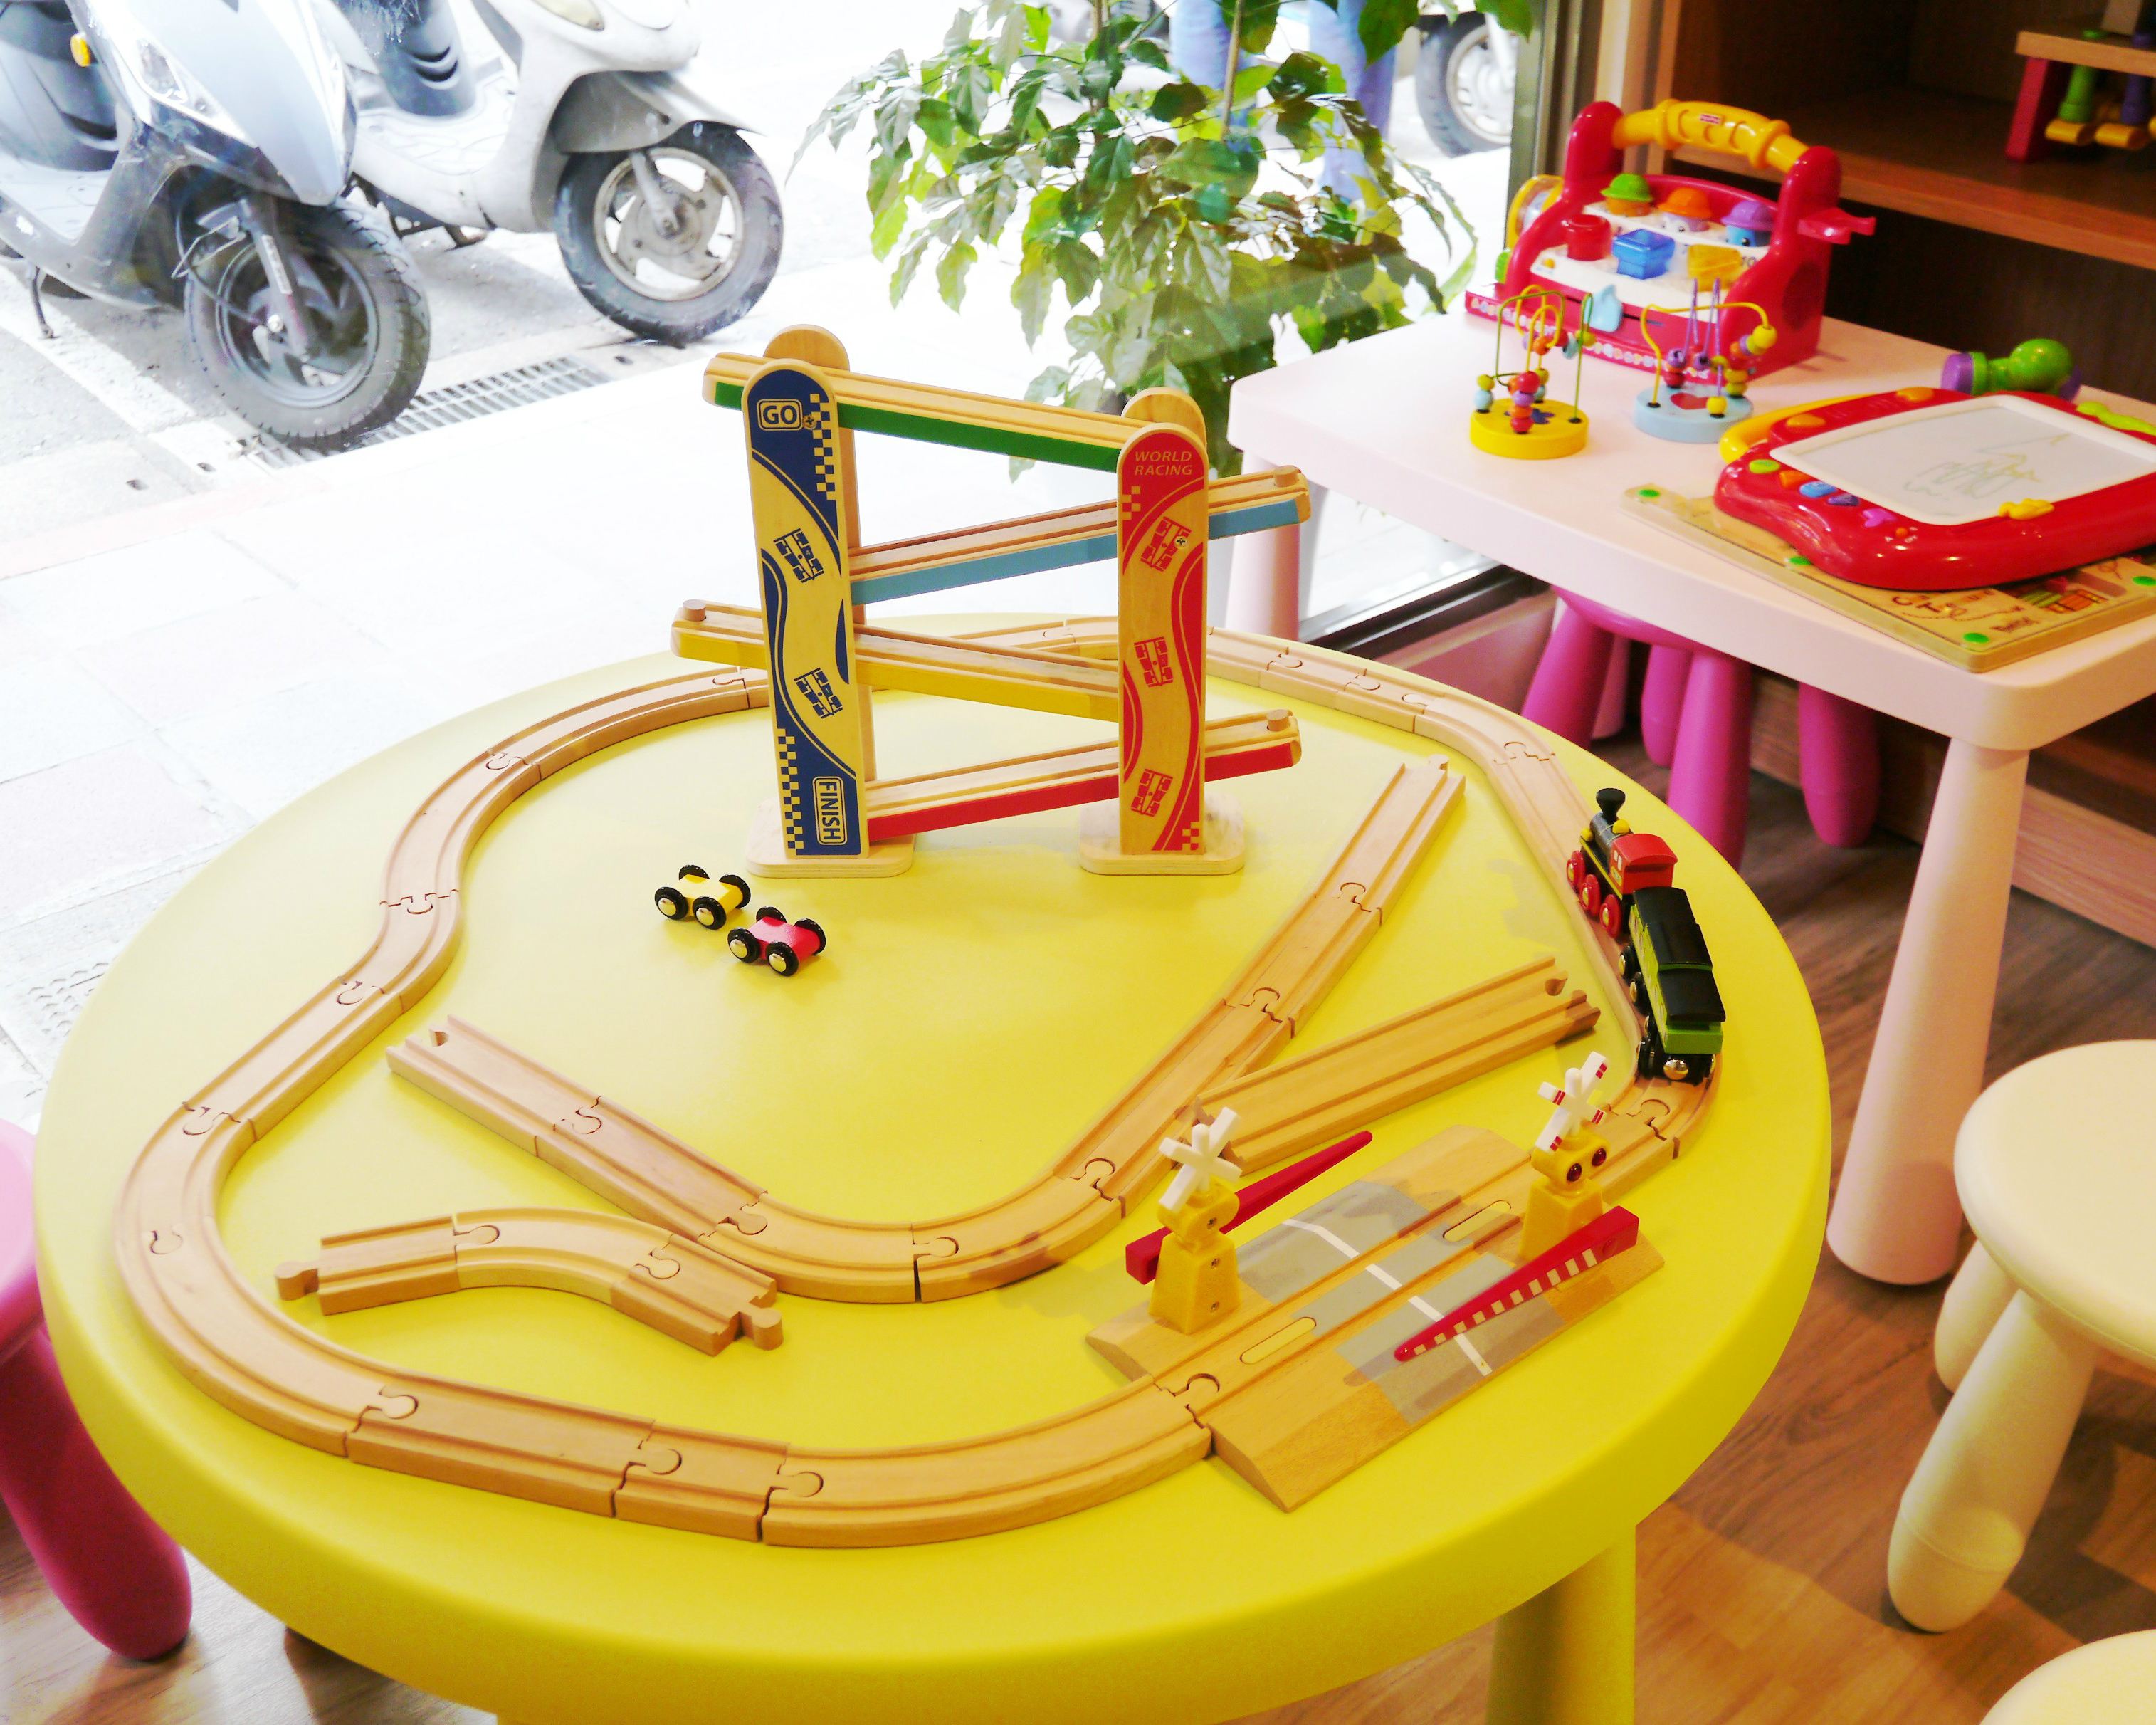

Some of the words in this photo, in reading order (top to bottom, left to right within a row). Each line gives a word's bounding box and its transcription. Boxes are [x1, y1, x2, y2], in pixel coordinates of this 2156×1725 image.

[762, 405, 797, 425] GO
[1135, 451, 1192, 462] WORLD
[1134, 464, 1193, 476] RACING
[819, 782, 841, 840] FINISH
